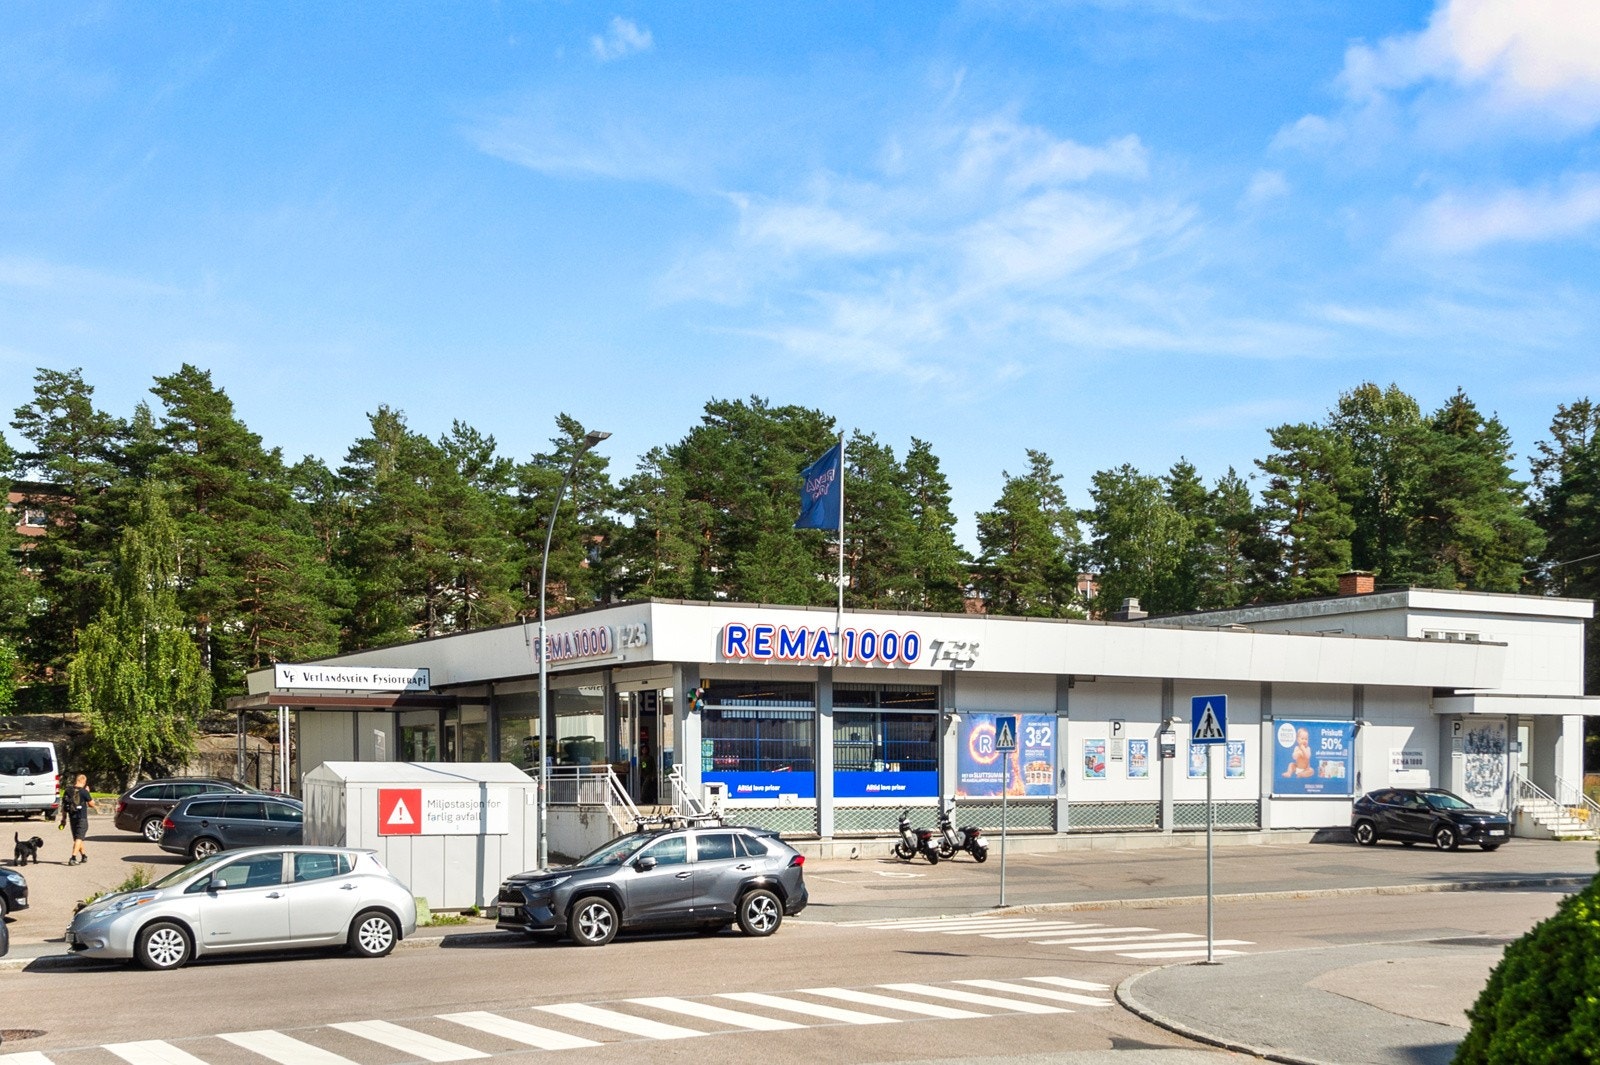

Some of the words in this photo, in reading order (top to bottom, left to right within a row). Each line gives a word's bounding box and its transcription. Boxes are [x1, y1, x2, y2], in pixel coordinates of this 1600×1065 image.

[533, 632, 573, 663] REMA
[574, 626, 609, 657] 1000
[723, 622, 834, 661] REMA
[842, 628, 921, 664] 1000
[373, 674, 427, 687] Fysioterapi
[1113, 721, 1122, 737] P
[1453, 722, 1461, 736] P
[1025, 726, 1035, 747] 3
[1041, 726, 1051, 747] 2
[980, 736, 992, 753] R
[1131, 743, 1137, 754] 3
[1140, 743, 1146, 754] 2
[1228, 745, 1233, 754] 3
[1237, 745, 1243, 754] 2
[1321, 738, 1343, 750] 50%
[427, 799, 485, 811] Miljøstasjon
[487, 799, 501, 809] for
[427, 812, 453, 823] farlig
[455, 812, 482, 822] avfall
